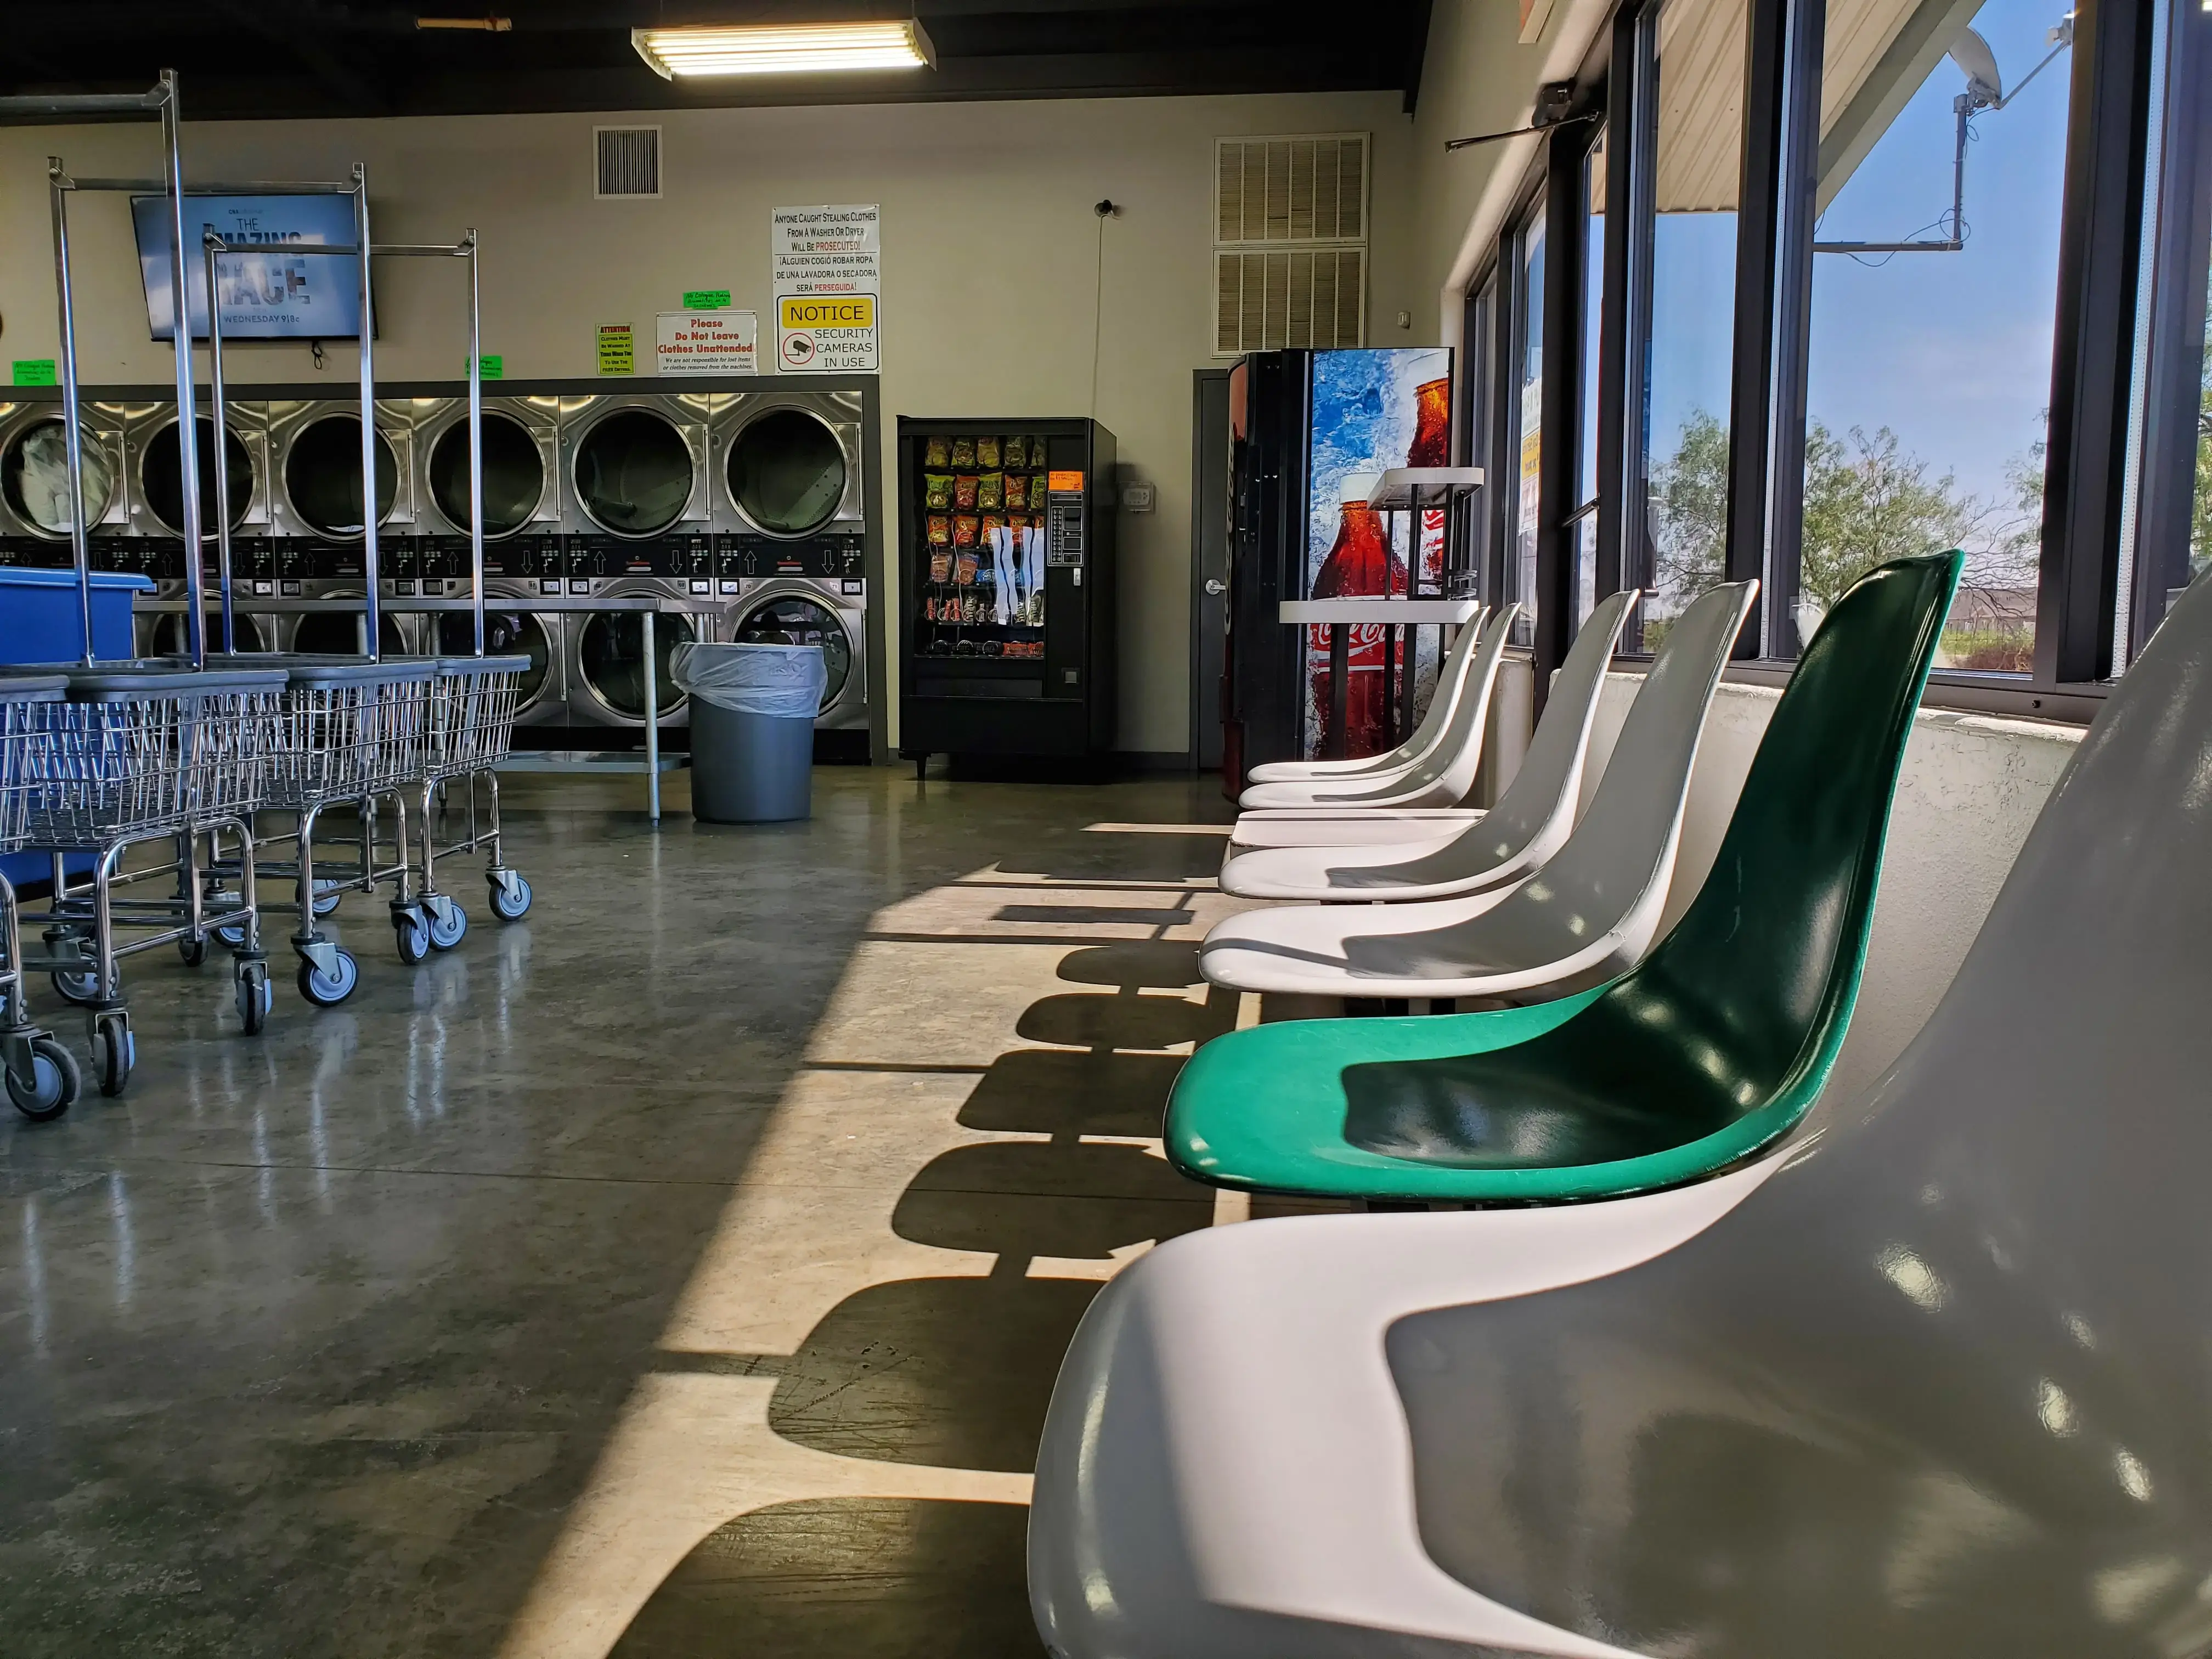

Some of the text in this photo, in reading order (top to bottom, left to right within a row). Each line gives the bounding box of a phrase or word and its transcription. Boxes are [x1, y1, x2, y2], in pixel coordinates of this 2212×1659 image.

[775, 212, 876, 223] ANYONE CAUGHT STEALING CLOTHES
[236, 218, 258, 231] THE
[787, 227, 864, 238] FROM A WASHER OR DRYER
[792, 241, 860, 252] WILL BE PROSECUTED!
[811, 255, 831, 264] COGIÓ
[832, 256, 854, 264] ROBAR
[856, 256, 873, 264] ROPA
[801, 270, 835, 279] LAVADORA
[843, 269, 877, 278] SECADORA
[797, 281, 857, 292] SERÁ PERSEGUIDA!
[791, 306, 864, 321] NOTICE
[224, 315, 281, 323] WEDNESDAY
[691, 318, 723, 328] Please
[675, 331, 739, 341] Do Not Leave
[815, 328, 873, 338] SECURITY
[658, 343, 753, 353] Clothes Unattended
[816, 343, 872, 353] CAMERAS
[824, 357, 865, 368] IN USE
